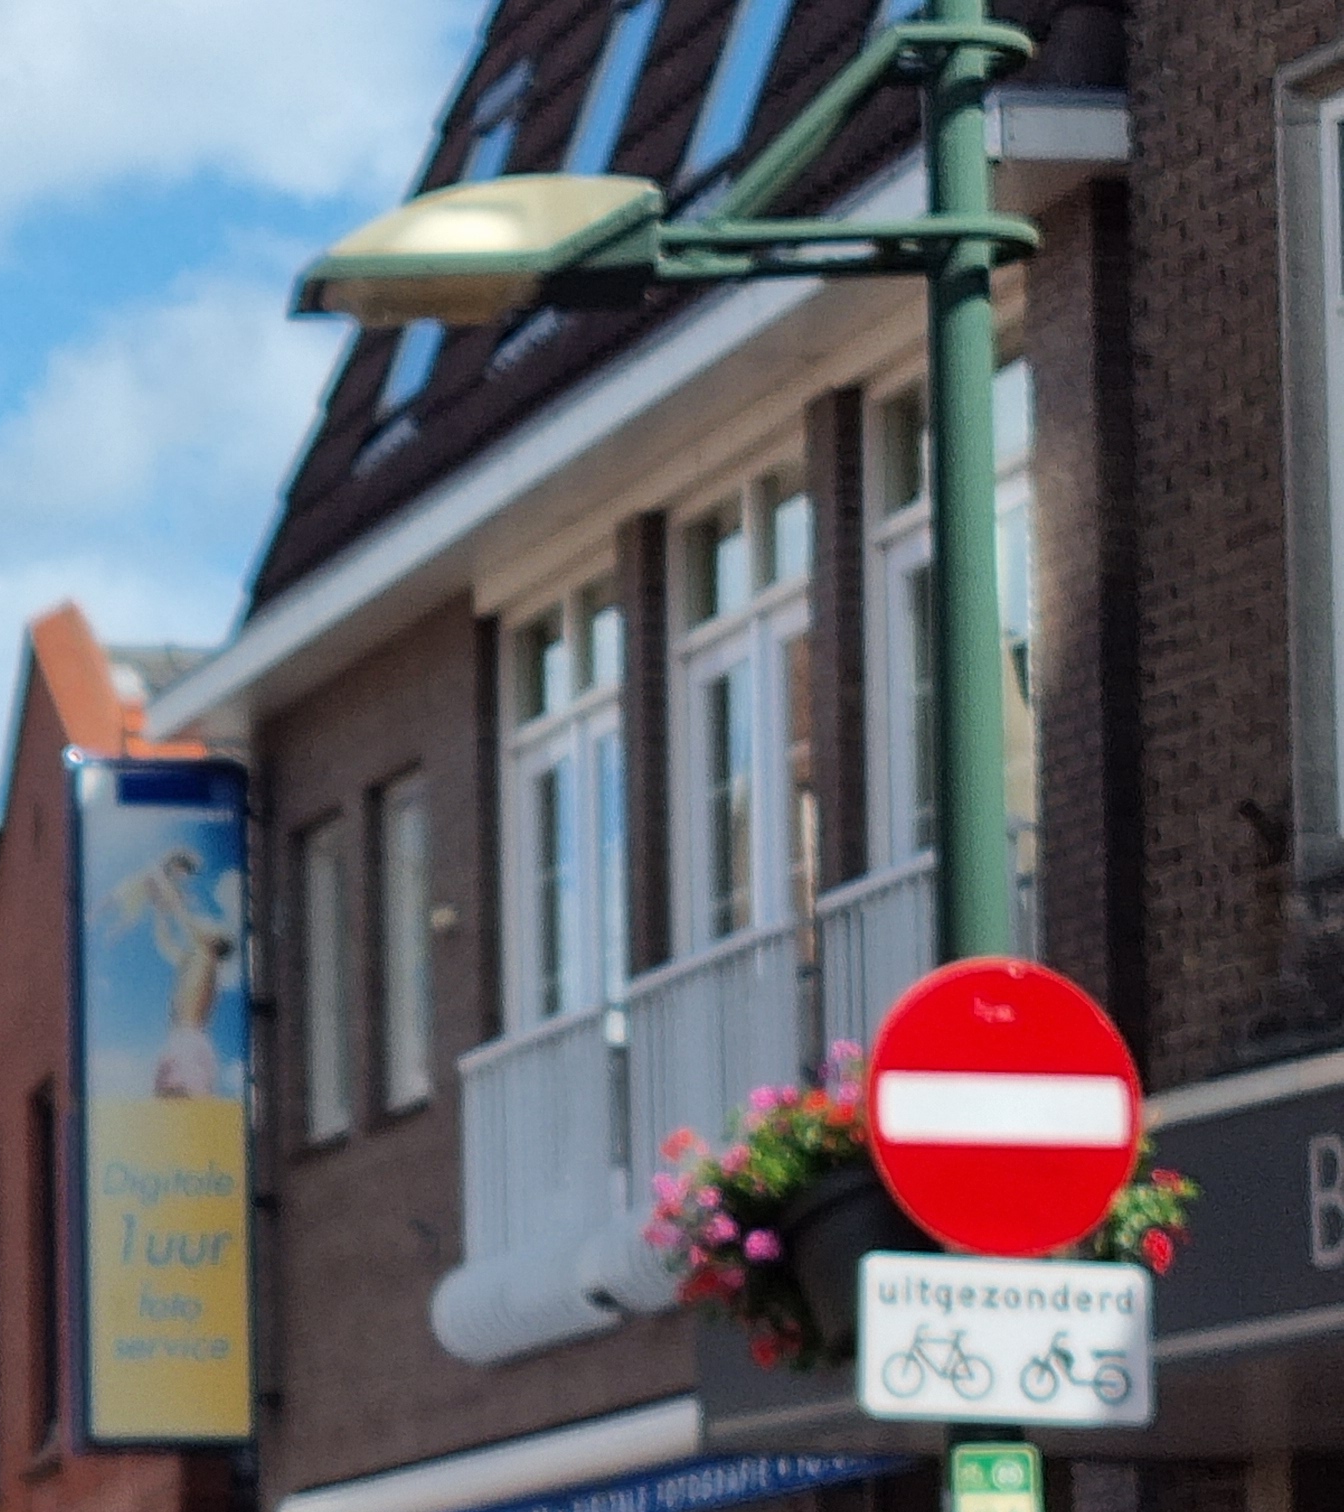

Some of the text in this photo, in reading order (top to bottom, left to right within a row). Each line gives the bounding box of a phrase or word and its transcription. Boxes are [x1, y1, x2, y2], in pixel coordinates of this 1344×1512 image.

[103, 1161, 234, 1206] Digitale
[877, 1277, 1135, 1316] uitgezonderd
[114, 1337, 230, 1361] service
